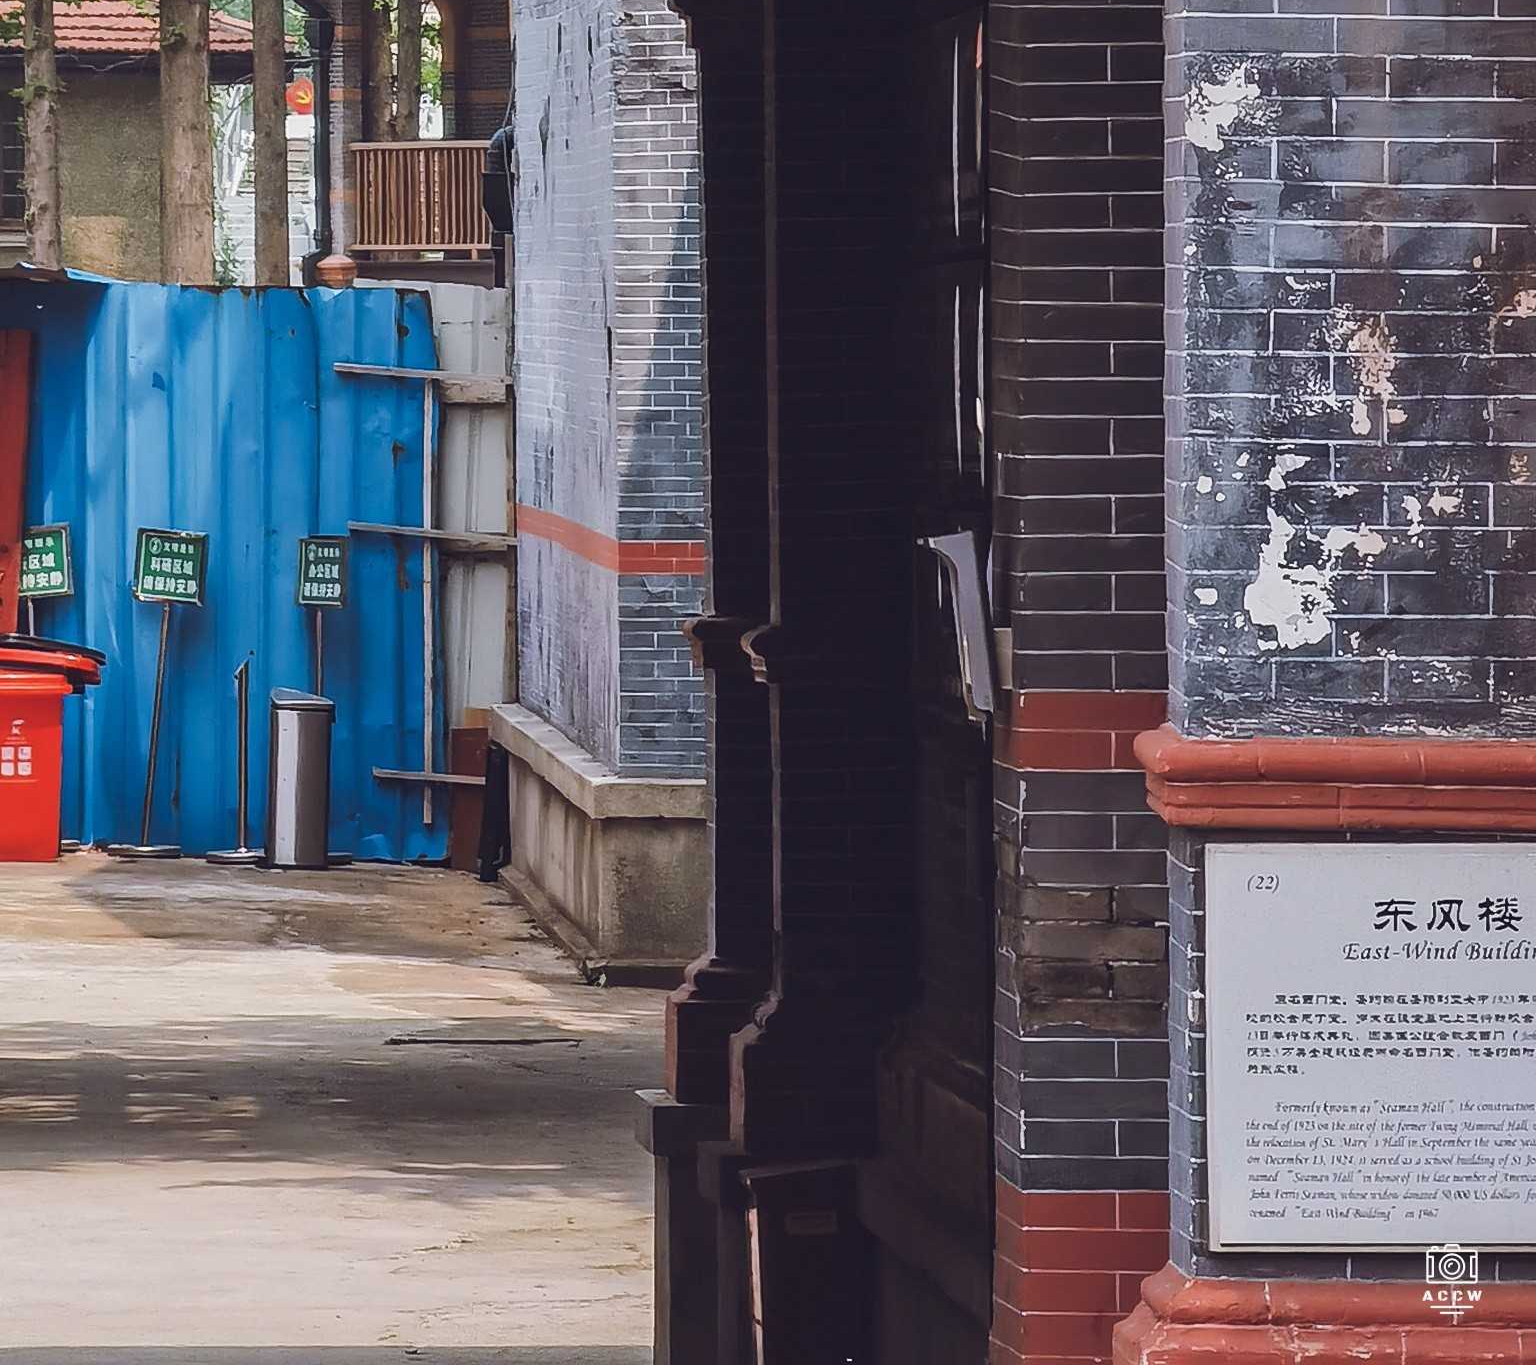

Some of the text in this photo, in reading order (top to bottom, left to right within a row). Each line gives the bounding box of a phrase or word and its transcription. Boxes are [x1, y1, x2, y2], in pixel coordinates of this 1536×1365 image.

[1247, 874, 1280, 894] (22)
[1373, 897, 1524, 933] 东风楼
[1342, 940, 1464, 961] East-Wind
